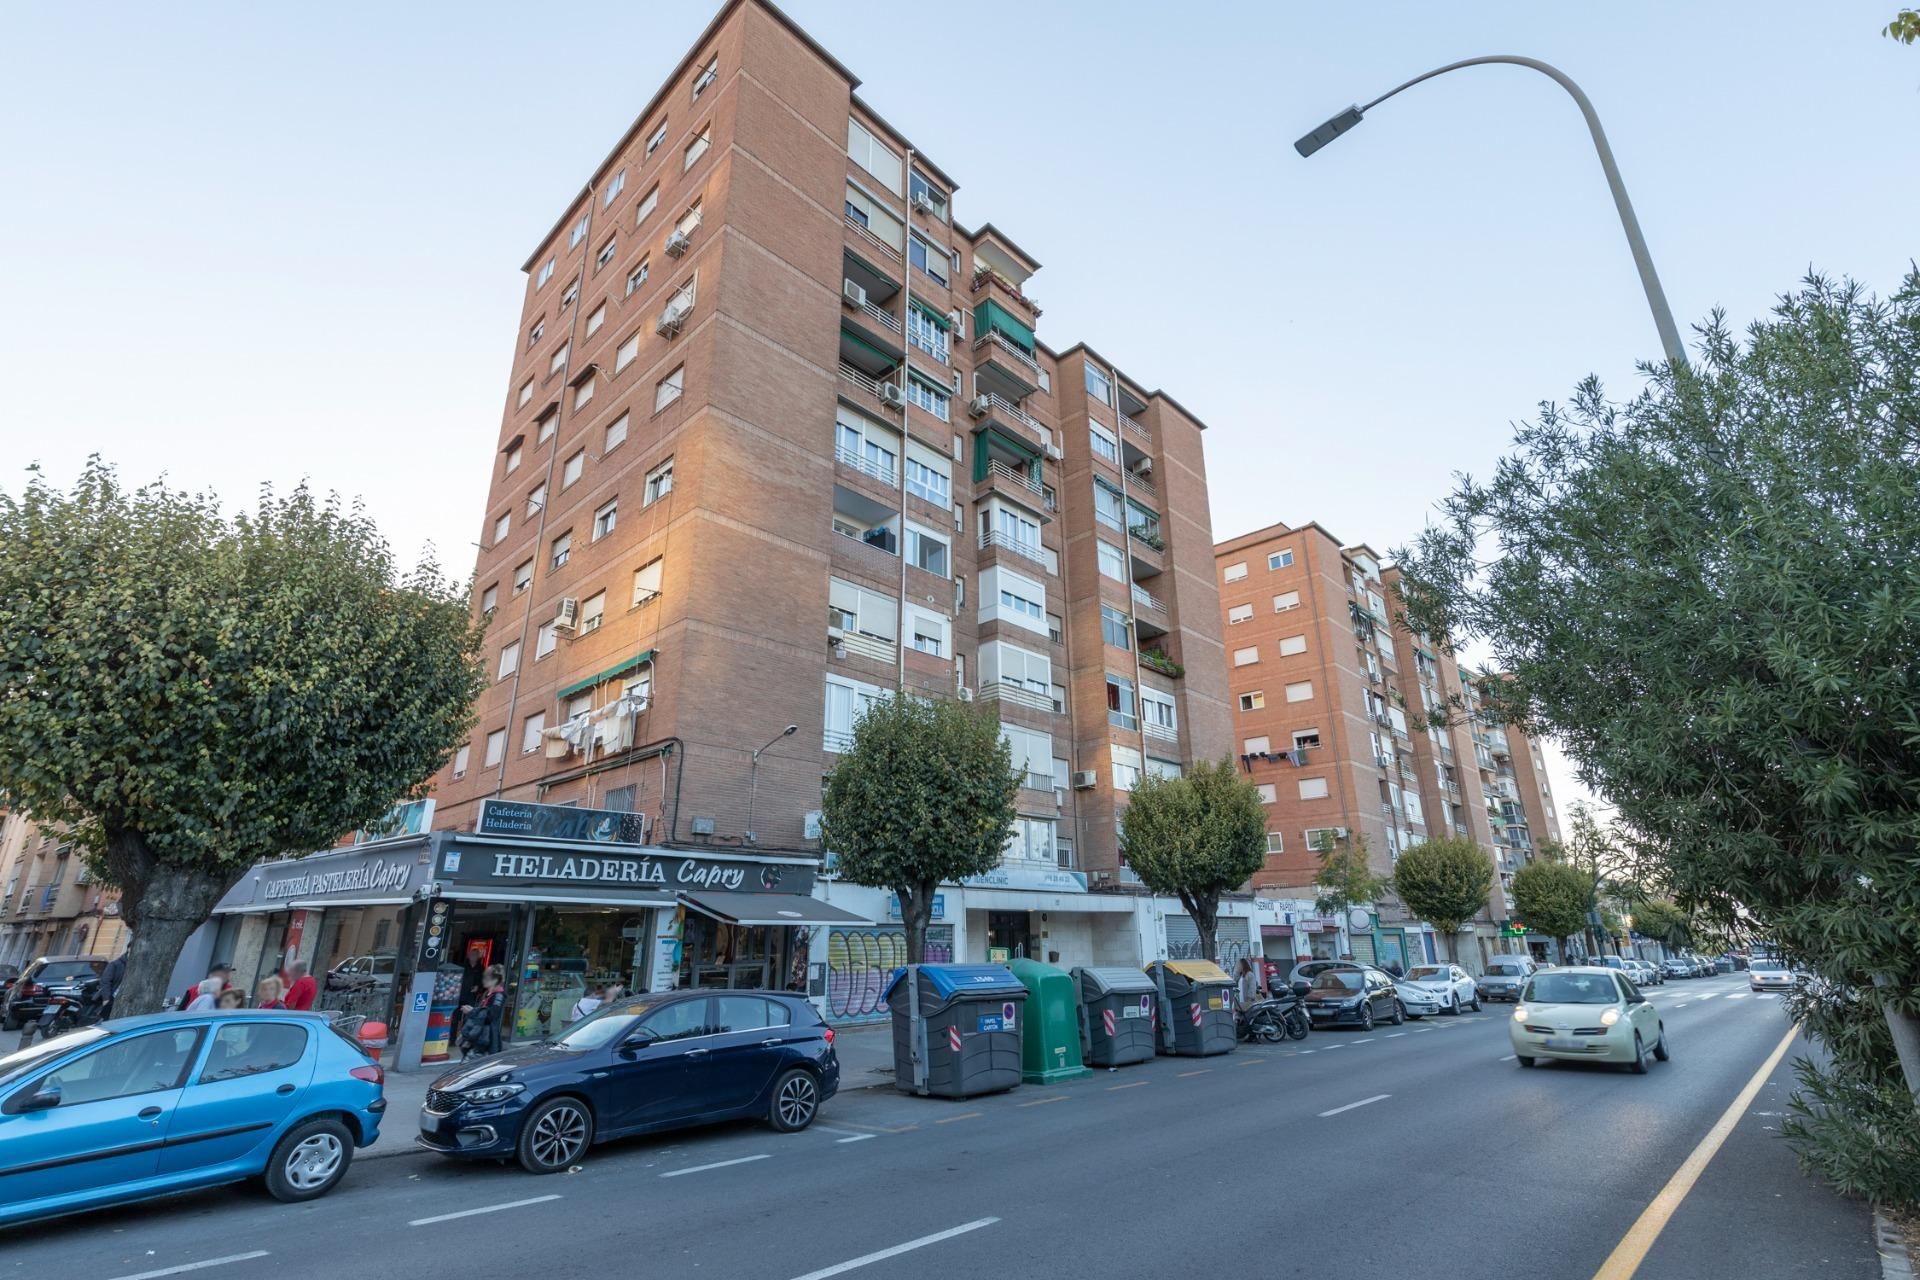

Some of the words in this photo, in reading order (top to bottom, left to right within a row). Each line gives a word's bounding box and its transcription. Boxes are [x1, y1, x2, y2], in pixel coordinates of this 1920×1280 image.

[264, 871, 309, 899] CAFETERÍA
[310, 862, 369, 894] PASTELERÍA
[369, 858, 412, 892] Capry
[491, 854, 666, 883] HELADERÍA
[676, 860, 745, 890] Capry
